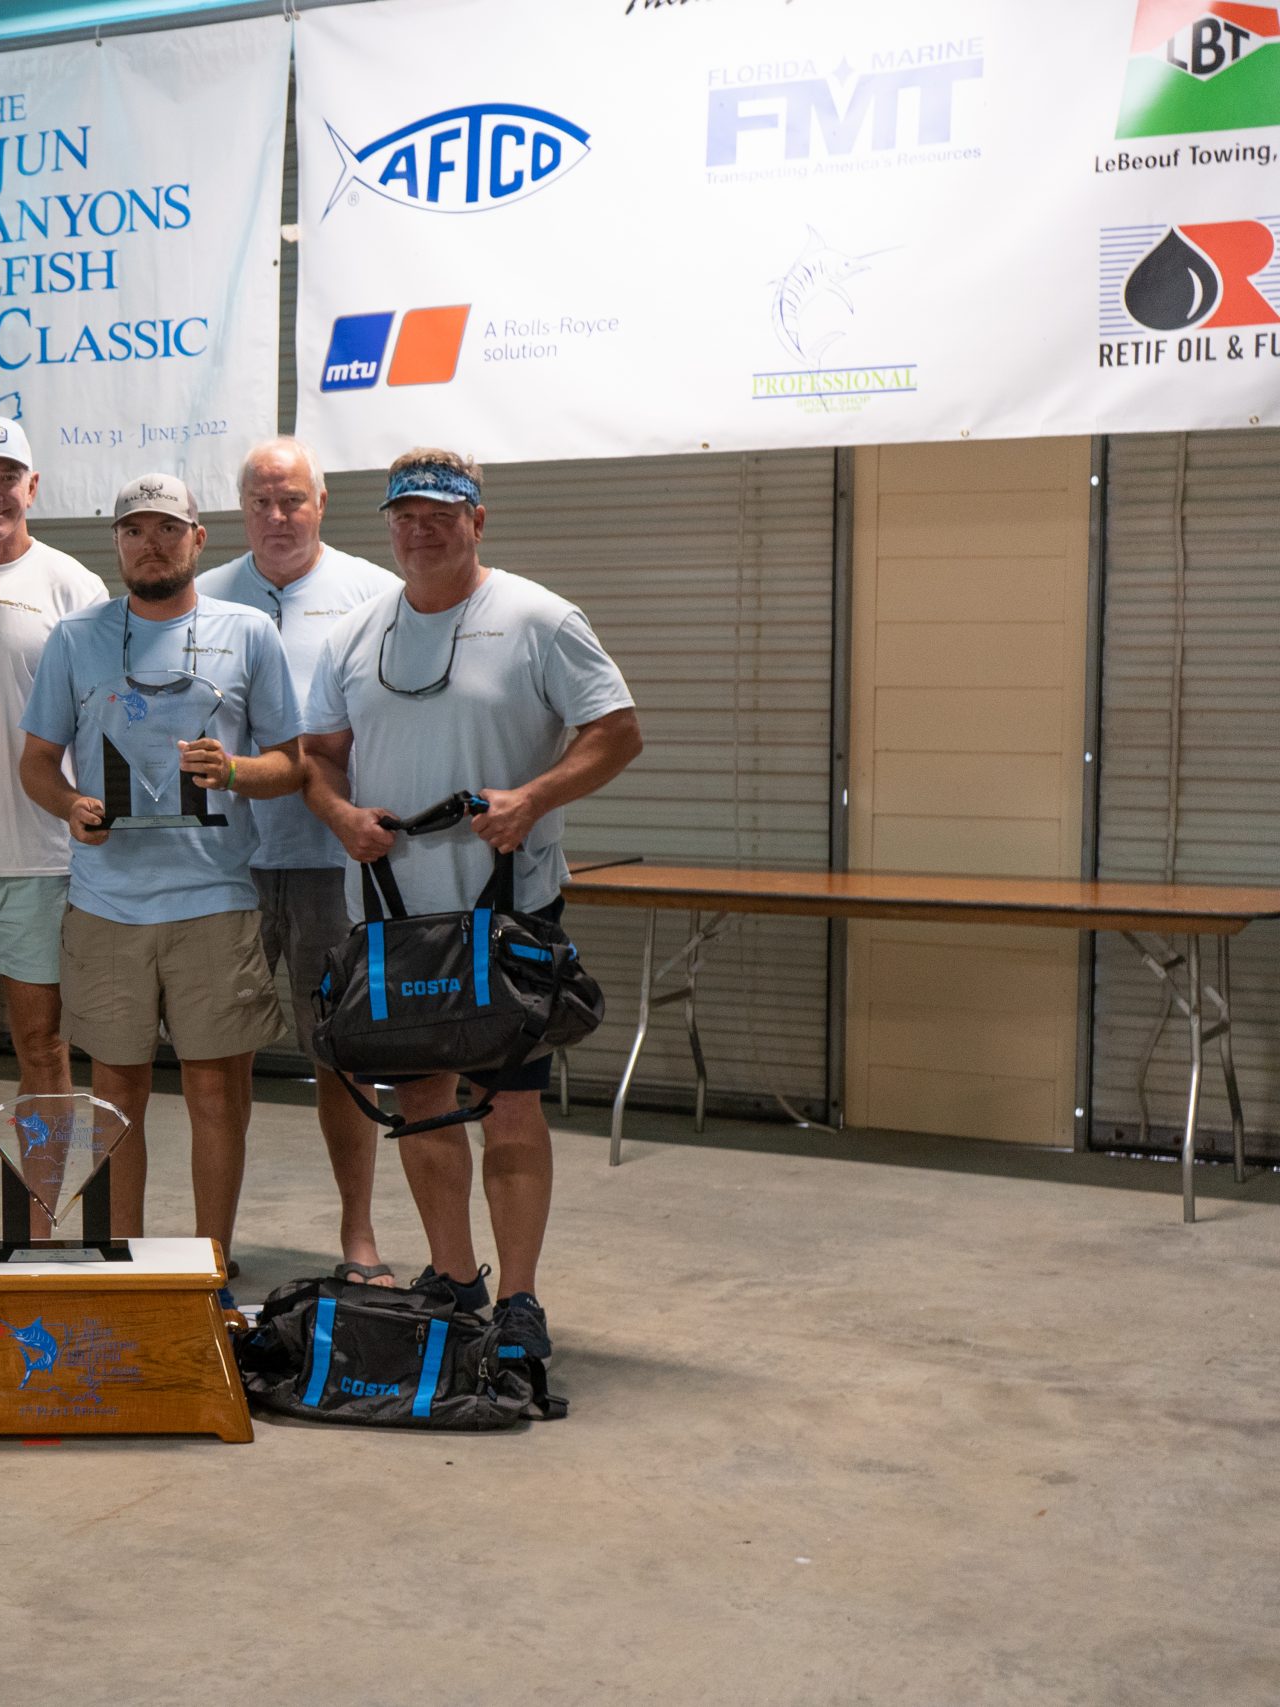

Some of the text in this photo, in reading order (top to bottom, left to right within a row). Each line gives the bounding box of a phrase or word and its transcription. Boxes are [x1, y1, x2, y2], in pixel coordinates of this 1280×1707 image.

[1167, 18, 1250, 75] LBT
[707, 37, 984, 87] FLORIDA MARINE
[706, 57, 984, 167] FMT
[370, 103, 580, 204] AFTCO
[705, 146, 981, 186] Transporting America's Resources
[1095, 143, 1277, 173] LeBeouf Towing,
[484, 315, 619, 338] A Rolls-Royce
[484, 343, 557, 361] solution
[1099, 340, 1168, 367] RETIF
[1178, 337, 1217, 362] OIL
[1227, 335, 1243, 360] &
[325, 359, 377, 382] mtu
[752, 368, 917, 396] PROFESSIONAL
[60, 427, 103, 446] MAY
[109, 430, 122, 448] 31
[194, 420, 228, 437] 2022
[401, 978, 462, 997] COSTA
[340, 1375, 401, 1398] COSTA
